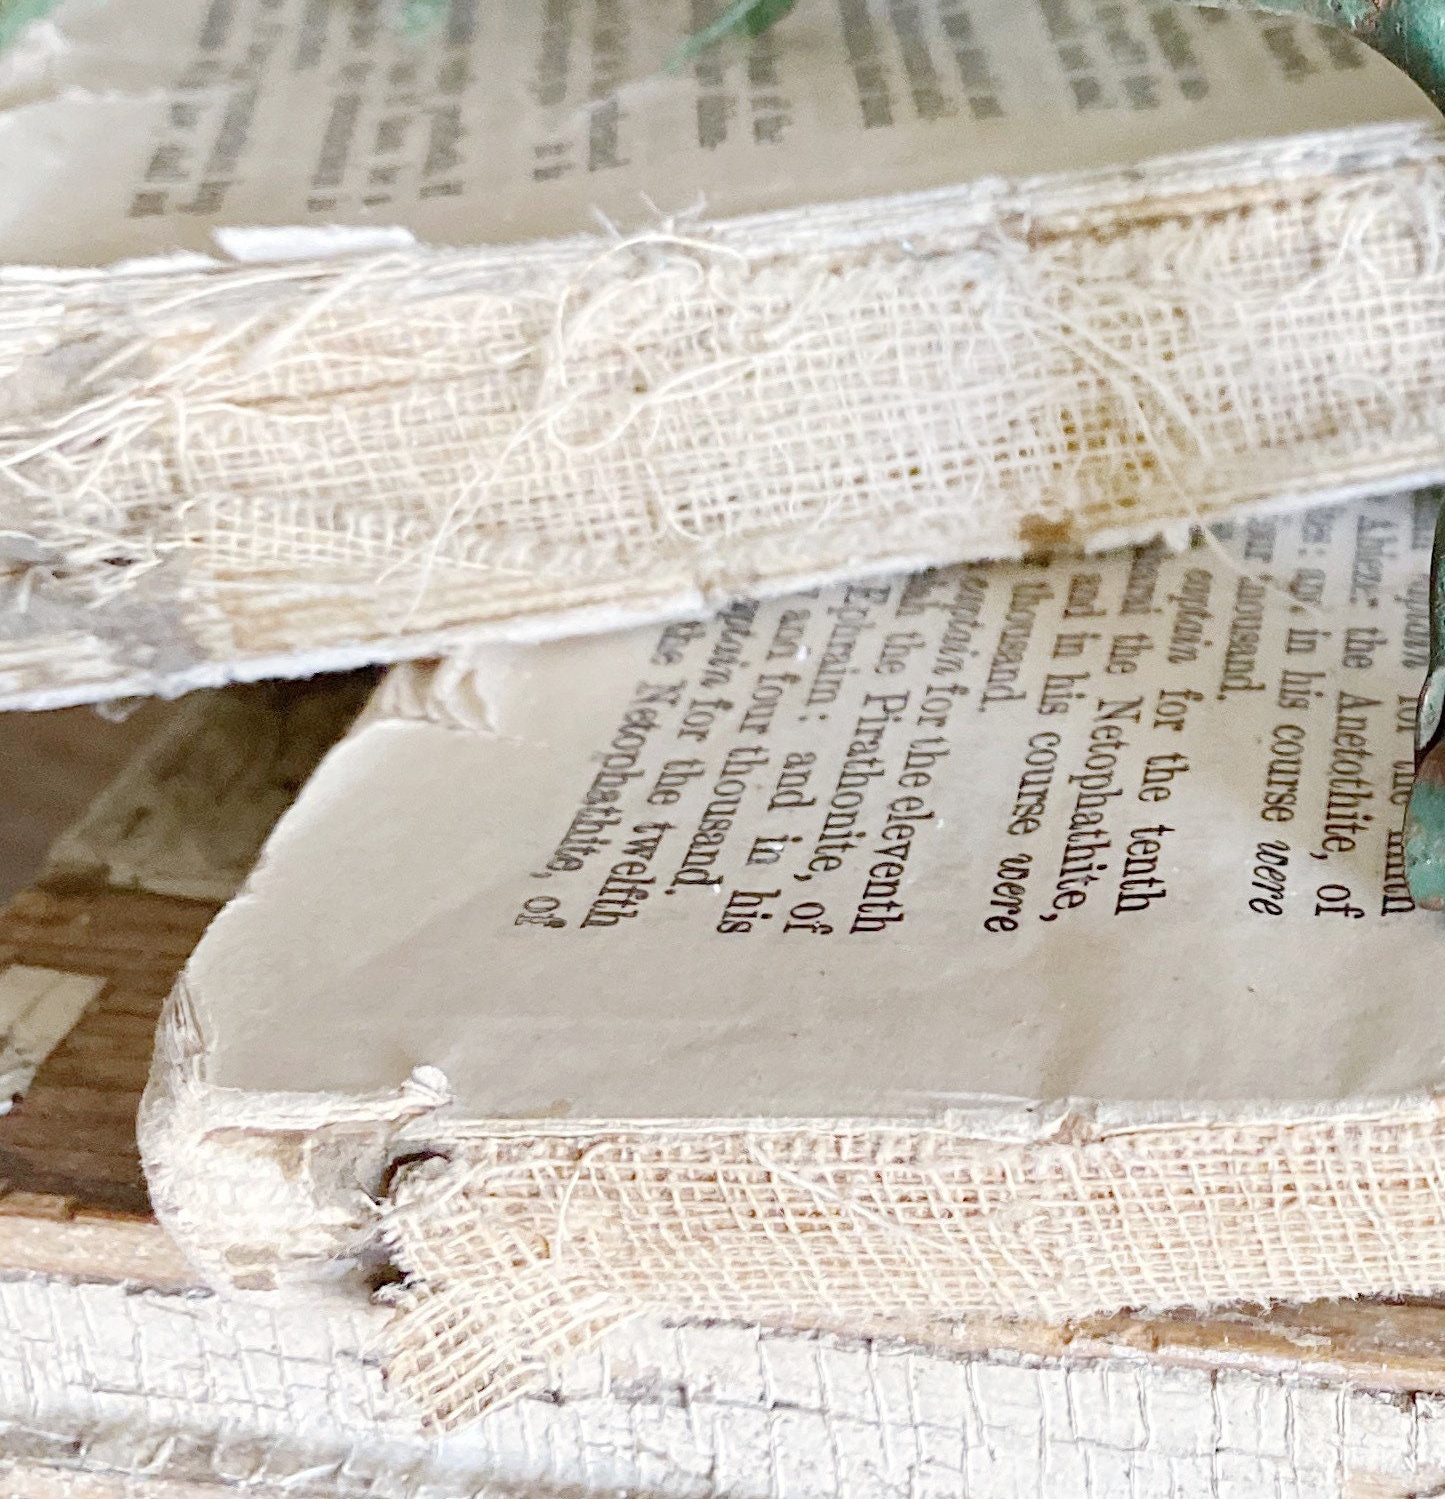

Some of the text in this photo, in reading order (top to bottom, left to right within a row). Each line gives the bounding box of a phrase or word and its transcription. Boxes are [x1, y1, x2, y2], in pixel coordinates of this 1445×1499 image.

[873, 630, 926, 676] the
[978, 581, 1055, 713] thousand.
[1052, 632, 1102, 658] in
[1105, 632, 1154, 675] the
[1285, 626, 1331, 654] in
[1342, 626, 1387, 670] the
[739, 671, 800, 734] four
[916, 684, 970, 725] for
[1038, 672, 1090, 716] his
[1280, 669, 1326, 710] his
[677, 698, 734, 742] for
[1114, 567, 1214, 917] captain for the tenth
[648, 758, 705, 806] the
[716, 584, 893, 935] Ephraim: and in his
[792, 691, 911, 882] Pirathonite,
[897, 737, 951, 787] the
[1008, 731, 1061, 836] course
[1260, 723, 1306, 822] course
[1310, 689, 1382, 861] Anetothite,
[664, 746, 770, 896] thousand.
[1039, 696, 1143, 922] Netophathite,
[580, 822, 676, 928] twelfth
[849, 796, 946, 936] eleventh
[984, 852, 1033, 932] were
[1249, 839, 1292, 917] were
[514, 896, 567, 928] of
[783, 901, 832, 936] of
[1314, 883, 1365, 919] of
